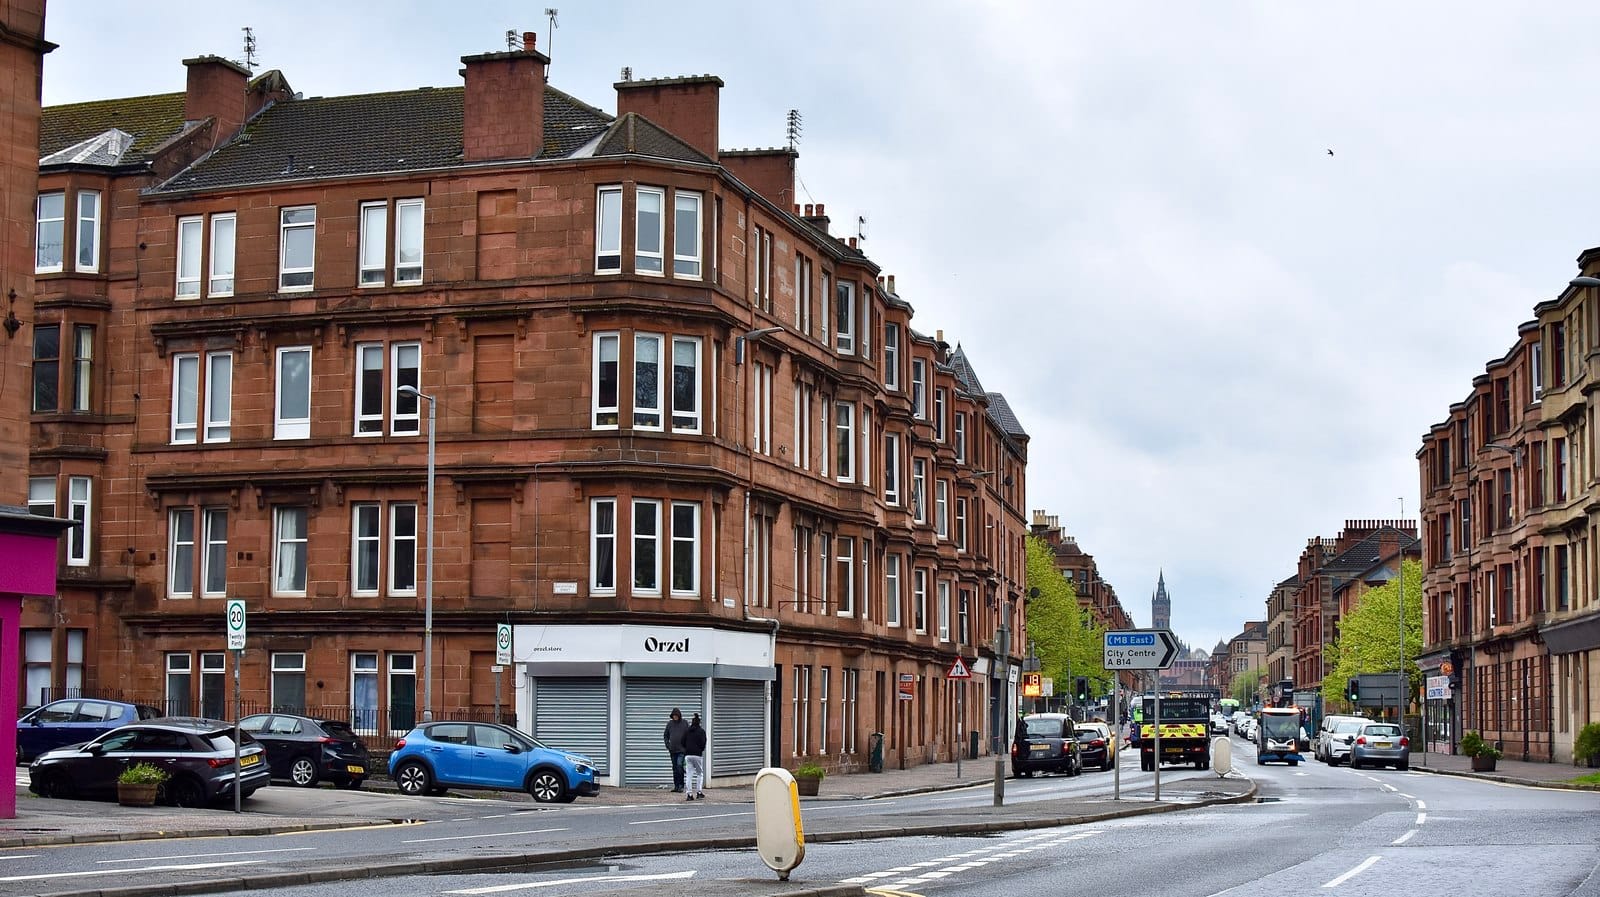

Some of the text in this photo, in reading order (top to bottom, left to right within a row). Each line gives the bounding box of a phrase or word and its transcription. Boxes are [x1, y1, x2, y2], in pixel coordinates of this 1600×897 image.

[232, 611, 242, 622] 20
[500, 633, 508, 643] 20
[1130, 635, 1154, 645] East)
[644, 636, 690, 653] Orzel
[1107, 649, 1156, 658] City Centre
[1107, 658, 1131, 666] A 814
[1029, 674, 1039, 685] 18
